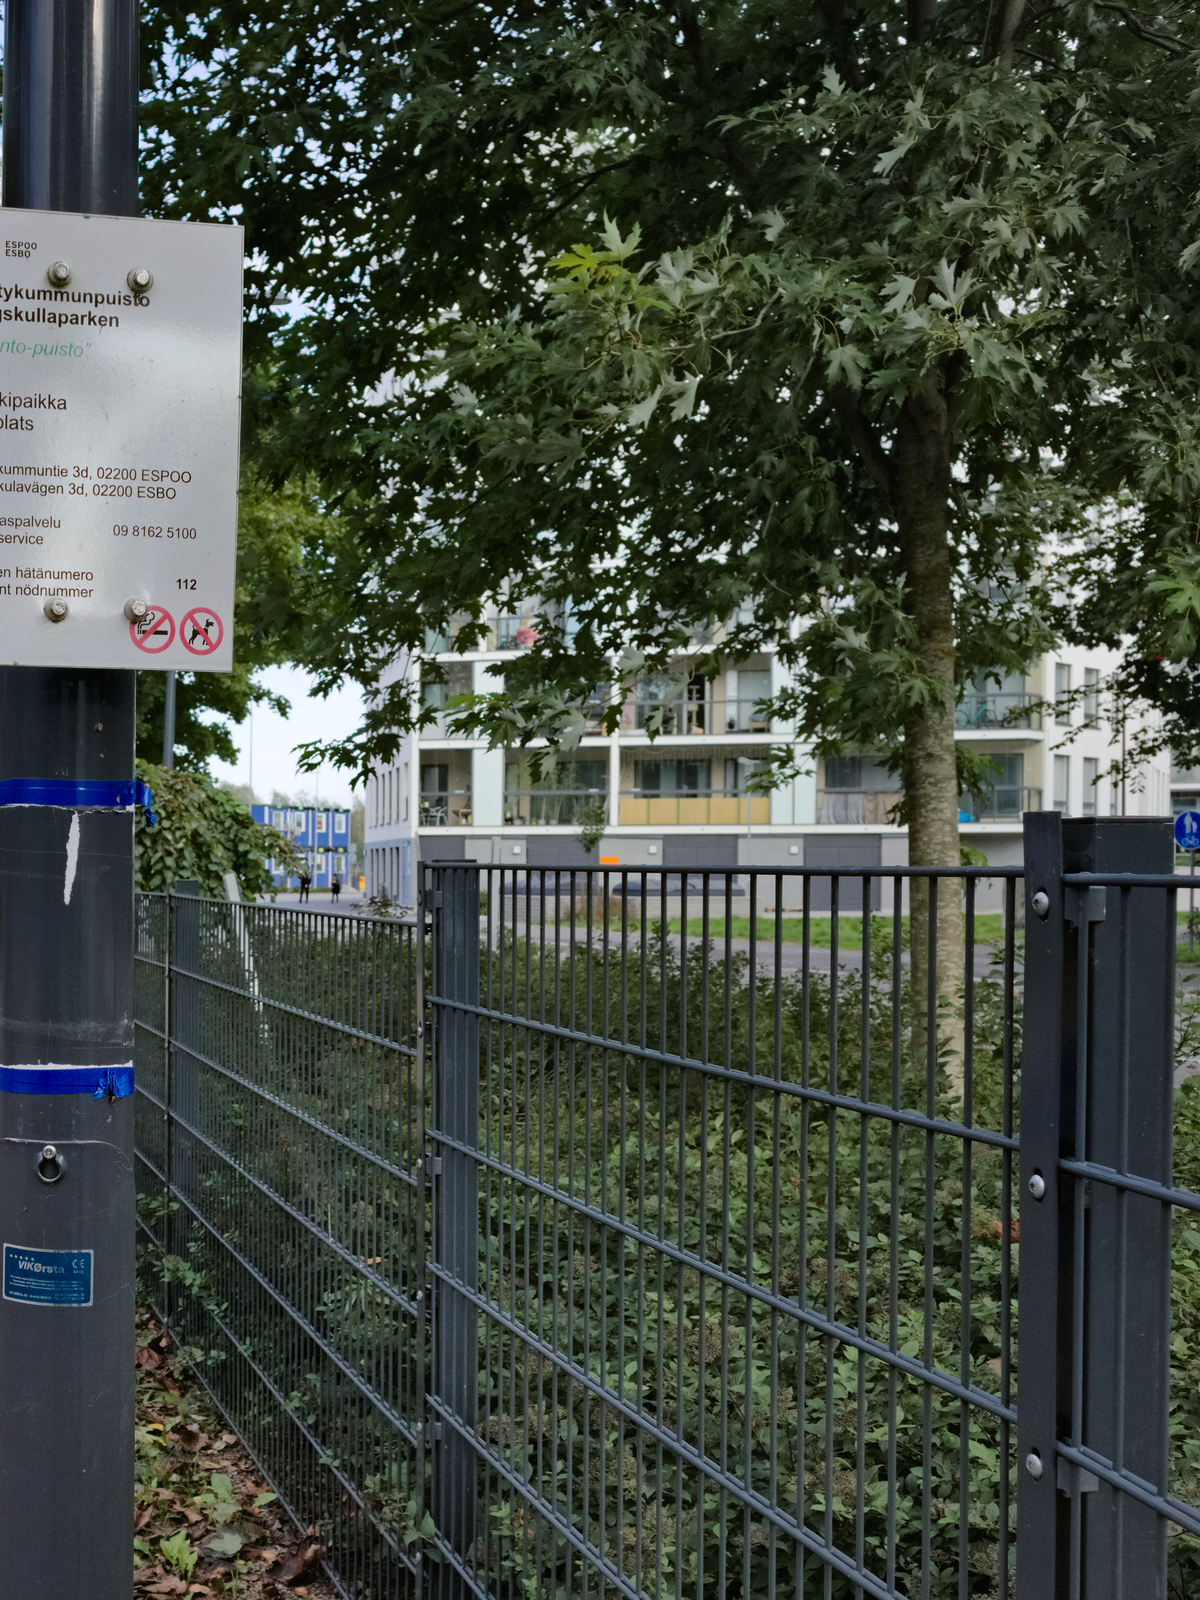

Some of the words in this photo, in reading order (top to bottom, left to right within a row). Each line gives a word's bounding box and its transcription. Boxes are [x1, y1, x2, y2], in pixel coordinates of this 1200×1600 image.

[5, 241, 38, 250] ESPOO
[5, 249, 31, 258] ESBO
[72, 466, 92, 480] 3d,
[96, 467, 137, 481] 02200
[141, 469, 192, 483] ESPOO
[68, 483, 88, 497] 3d,
[92, 484, 133, 498] 02200
[137, 486, 176, 500] ESBO
[113, 525, 128, 537] 09
[132, 525, 163, 538] 8162
[166, 526, 197, 539] 5100
[15, 566, 94, 581] hätänumero
[15, 584, 94, 598] nödnummer
[176, 578, 197, 591] 112
